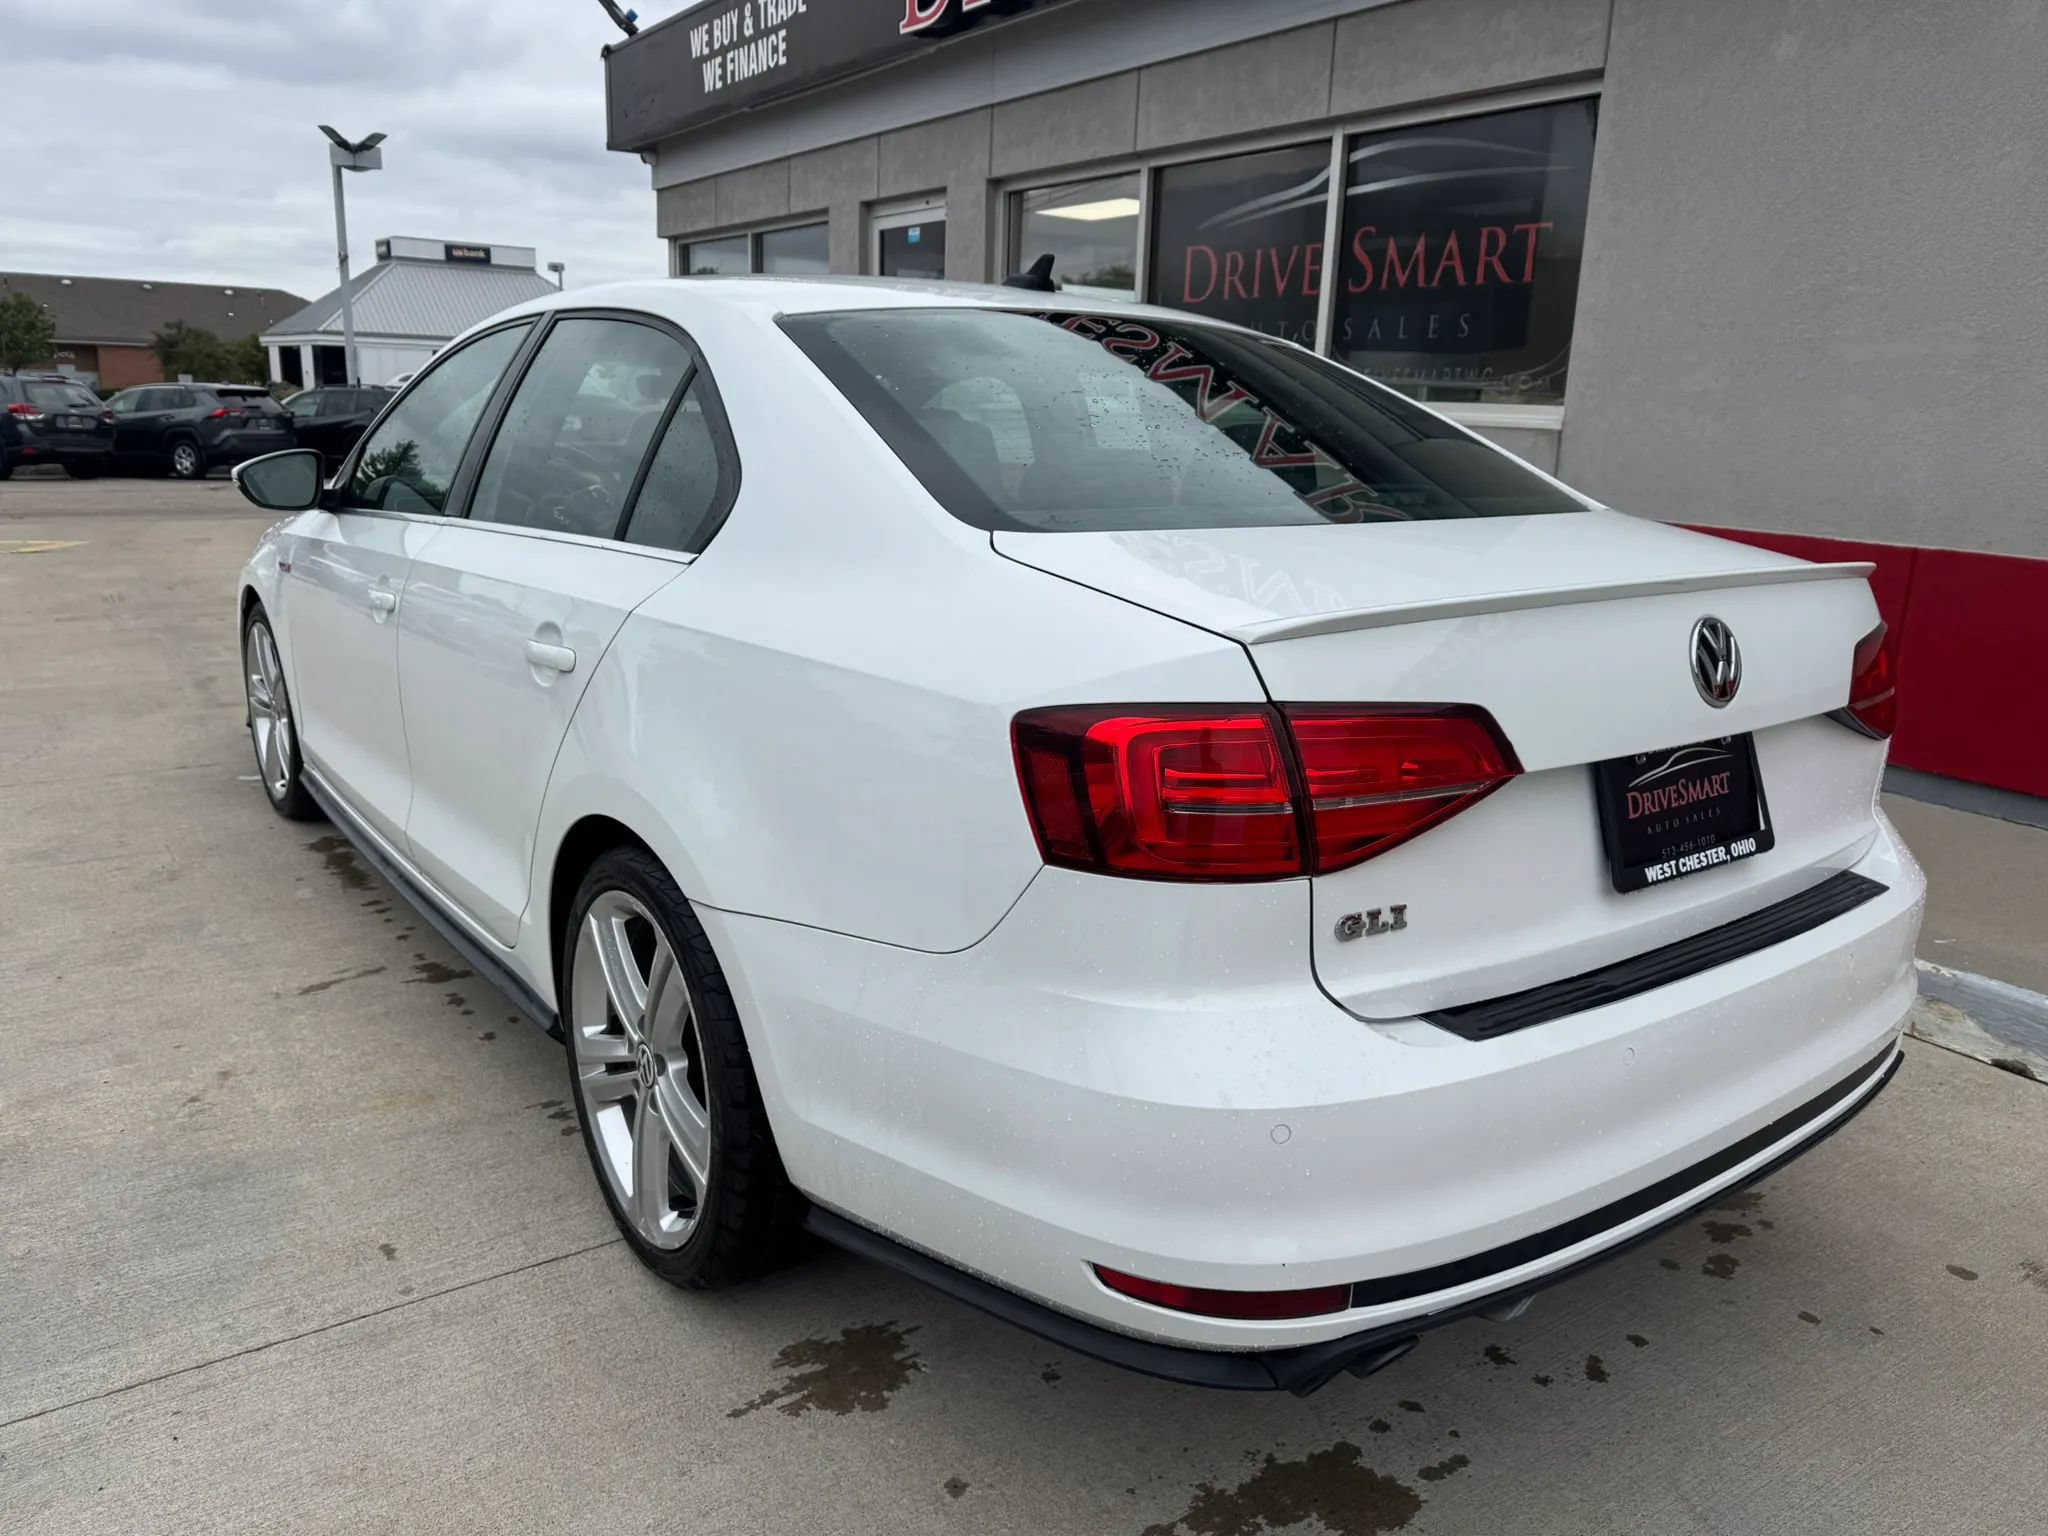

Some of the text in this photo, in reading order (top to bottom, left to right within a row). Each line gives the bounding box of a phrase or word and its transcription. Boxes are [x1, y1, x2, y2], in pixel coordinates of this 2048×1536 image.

[690, 23, 709, 58] WE
[713, 8, 738, 50] BUY
[744, 2, 754, 37] &
[703, 29, 787, 93] WE FINANCE
[1343, 313, 1471, 340] SALES
[1626, 771, 1731, 819] DRIVESMART
[1647, 807, 1722, 835] AUTO SALES
[1645, 838, 1757, 883] WEST CHESTER, OHIO
[1334, 904, 1408, 942] GLI
